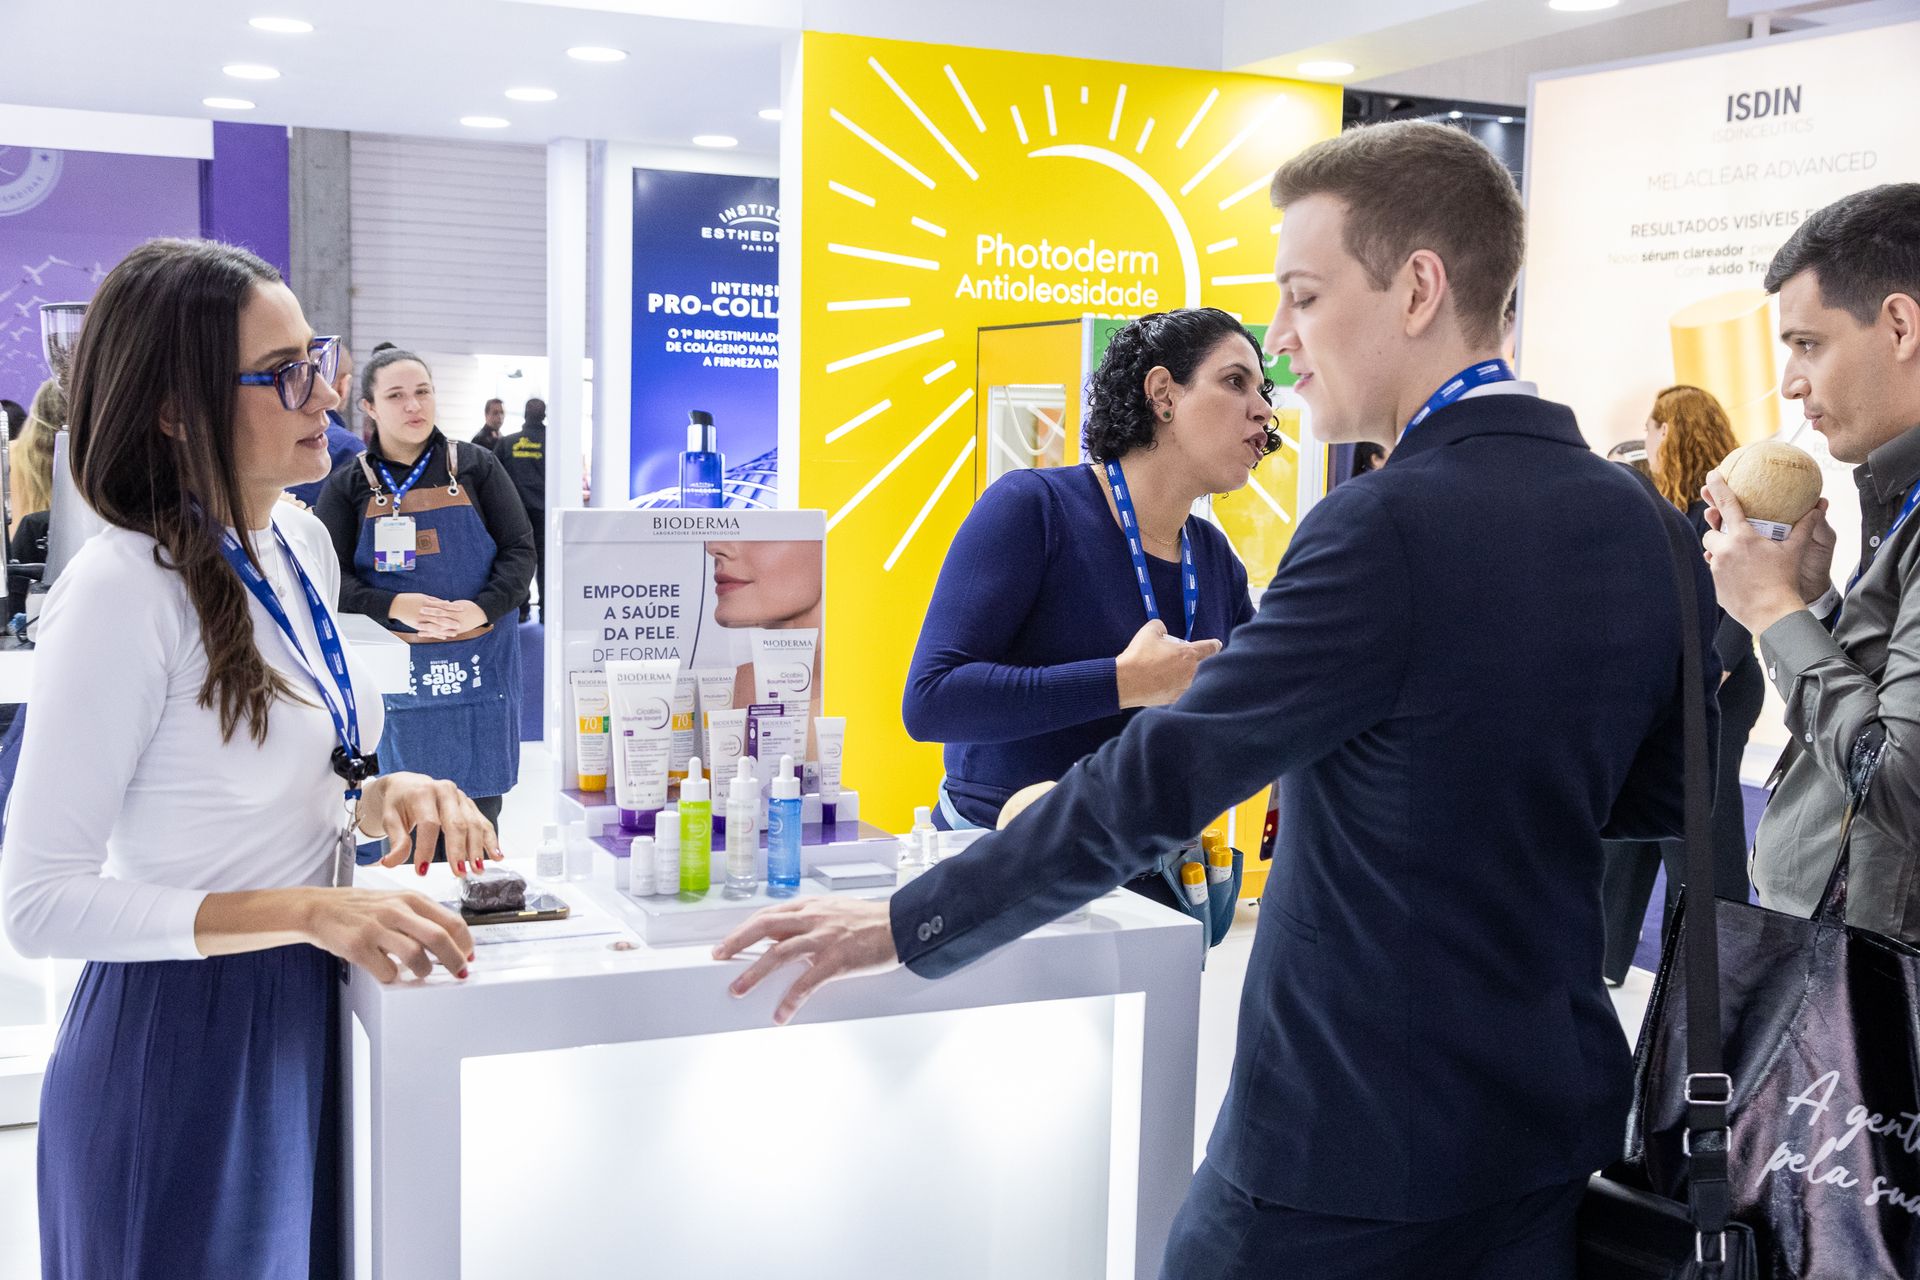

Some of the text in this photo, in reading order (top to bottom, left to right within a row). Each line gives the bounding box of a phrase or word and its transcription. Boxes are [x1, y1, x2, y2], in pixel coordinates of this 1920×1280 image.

[1726, 85, 1802, 122] ISDIN
[1647, 150, 1877, 191] MELACLEAR ADVANCED
[1631, 216, 1728, 238] RESULTADOS
[1734, 208, 1800, 230] VISÍVEIS
[741, 244, 774, 253] PARIS
[976, 233, 1159, 275] Photoderm
[1641, 247, 1680, 263] sérum
[1682, 244, 1744, 260] clareador
[1707, 261, 1744, 276] ácido
[955, 274, 1159, 308] Antioleosidade
[648, 293, 780, 319] PRO-COLL
[667, 327, 679, 339] O
[665, 341, 779, 356] DE COLÁGENO PARA
[702, 356, 712, 367] A
[713, 356, 762, 369] FIRMEZA
[653, 516, 740, 529] BIODERMA
[583, 584, 680, 599] EMPODERE
[604, 602, 680, 620] A SAÚDE
[604, 626, 679, 641] DA PELE.
[763, 639, 813, 648] BIODERMA
[593, 646, 681, 663] DE FORMA
[430, 662, 460, 675] mil
[422, 669, 468, 686] sabo
[617, 672, 672, 682] BIODERMA
[431, 681, 462, 696] res
[584, 716, 598, 730] 70
[677, 713, 689, 727] 70
[1787, 1070, 1920, 1153] A gent
[1755, 1136, 1859, 1188] pela
